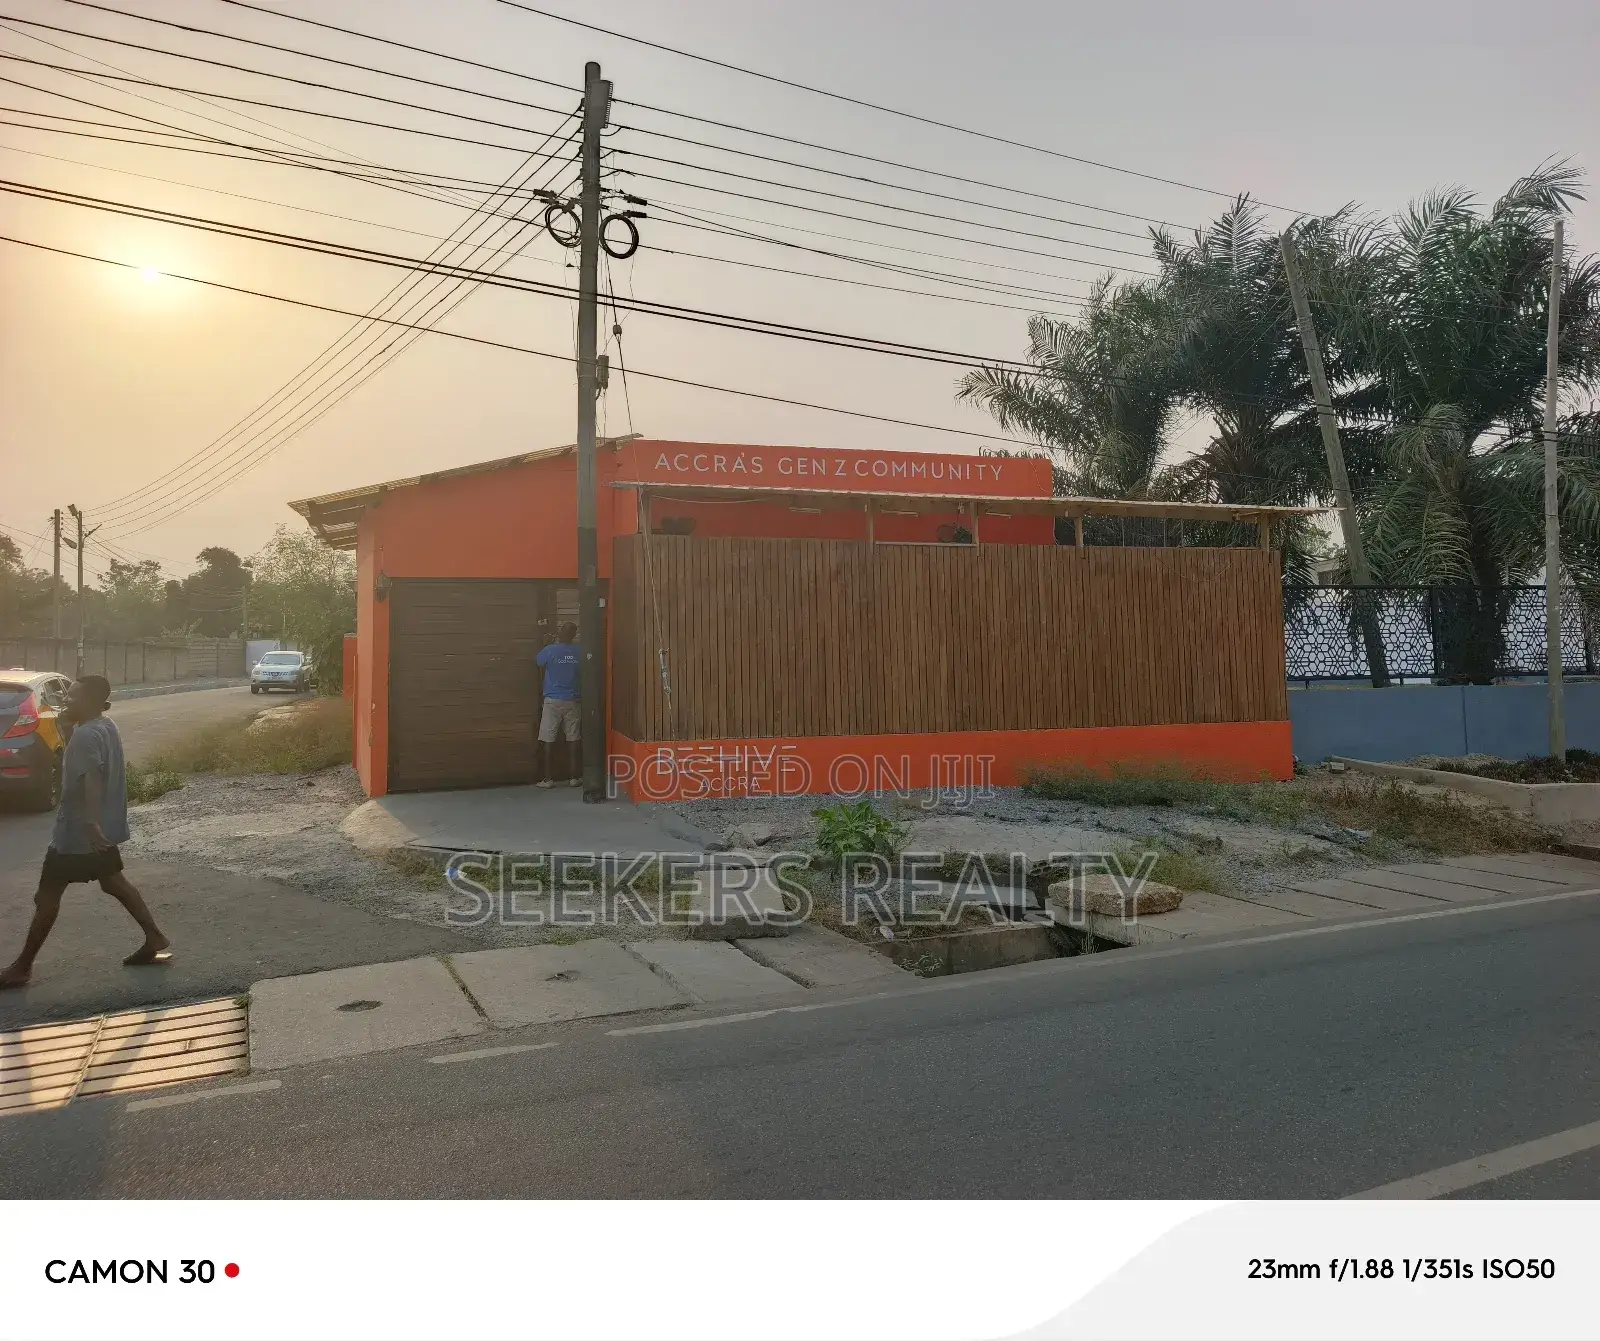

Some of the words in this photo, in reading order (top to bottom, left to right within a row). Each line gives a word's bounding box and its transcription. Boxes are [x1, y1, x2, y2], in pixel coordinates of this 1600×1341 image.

[778, 457, 827, 476] GEN
[834, 459, 847, 476] Z
[854, 459, 1003, 481] COMMUNITY
[656, 745, 797, 775] BEEHIVE
[699, 776, 761, 792] ACCRA
